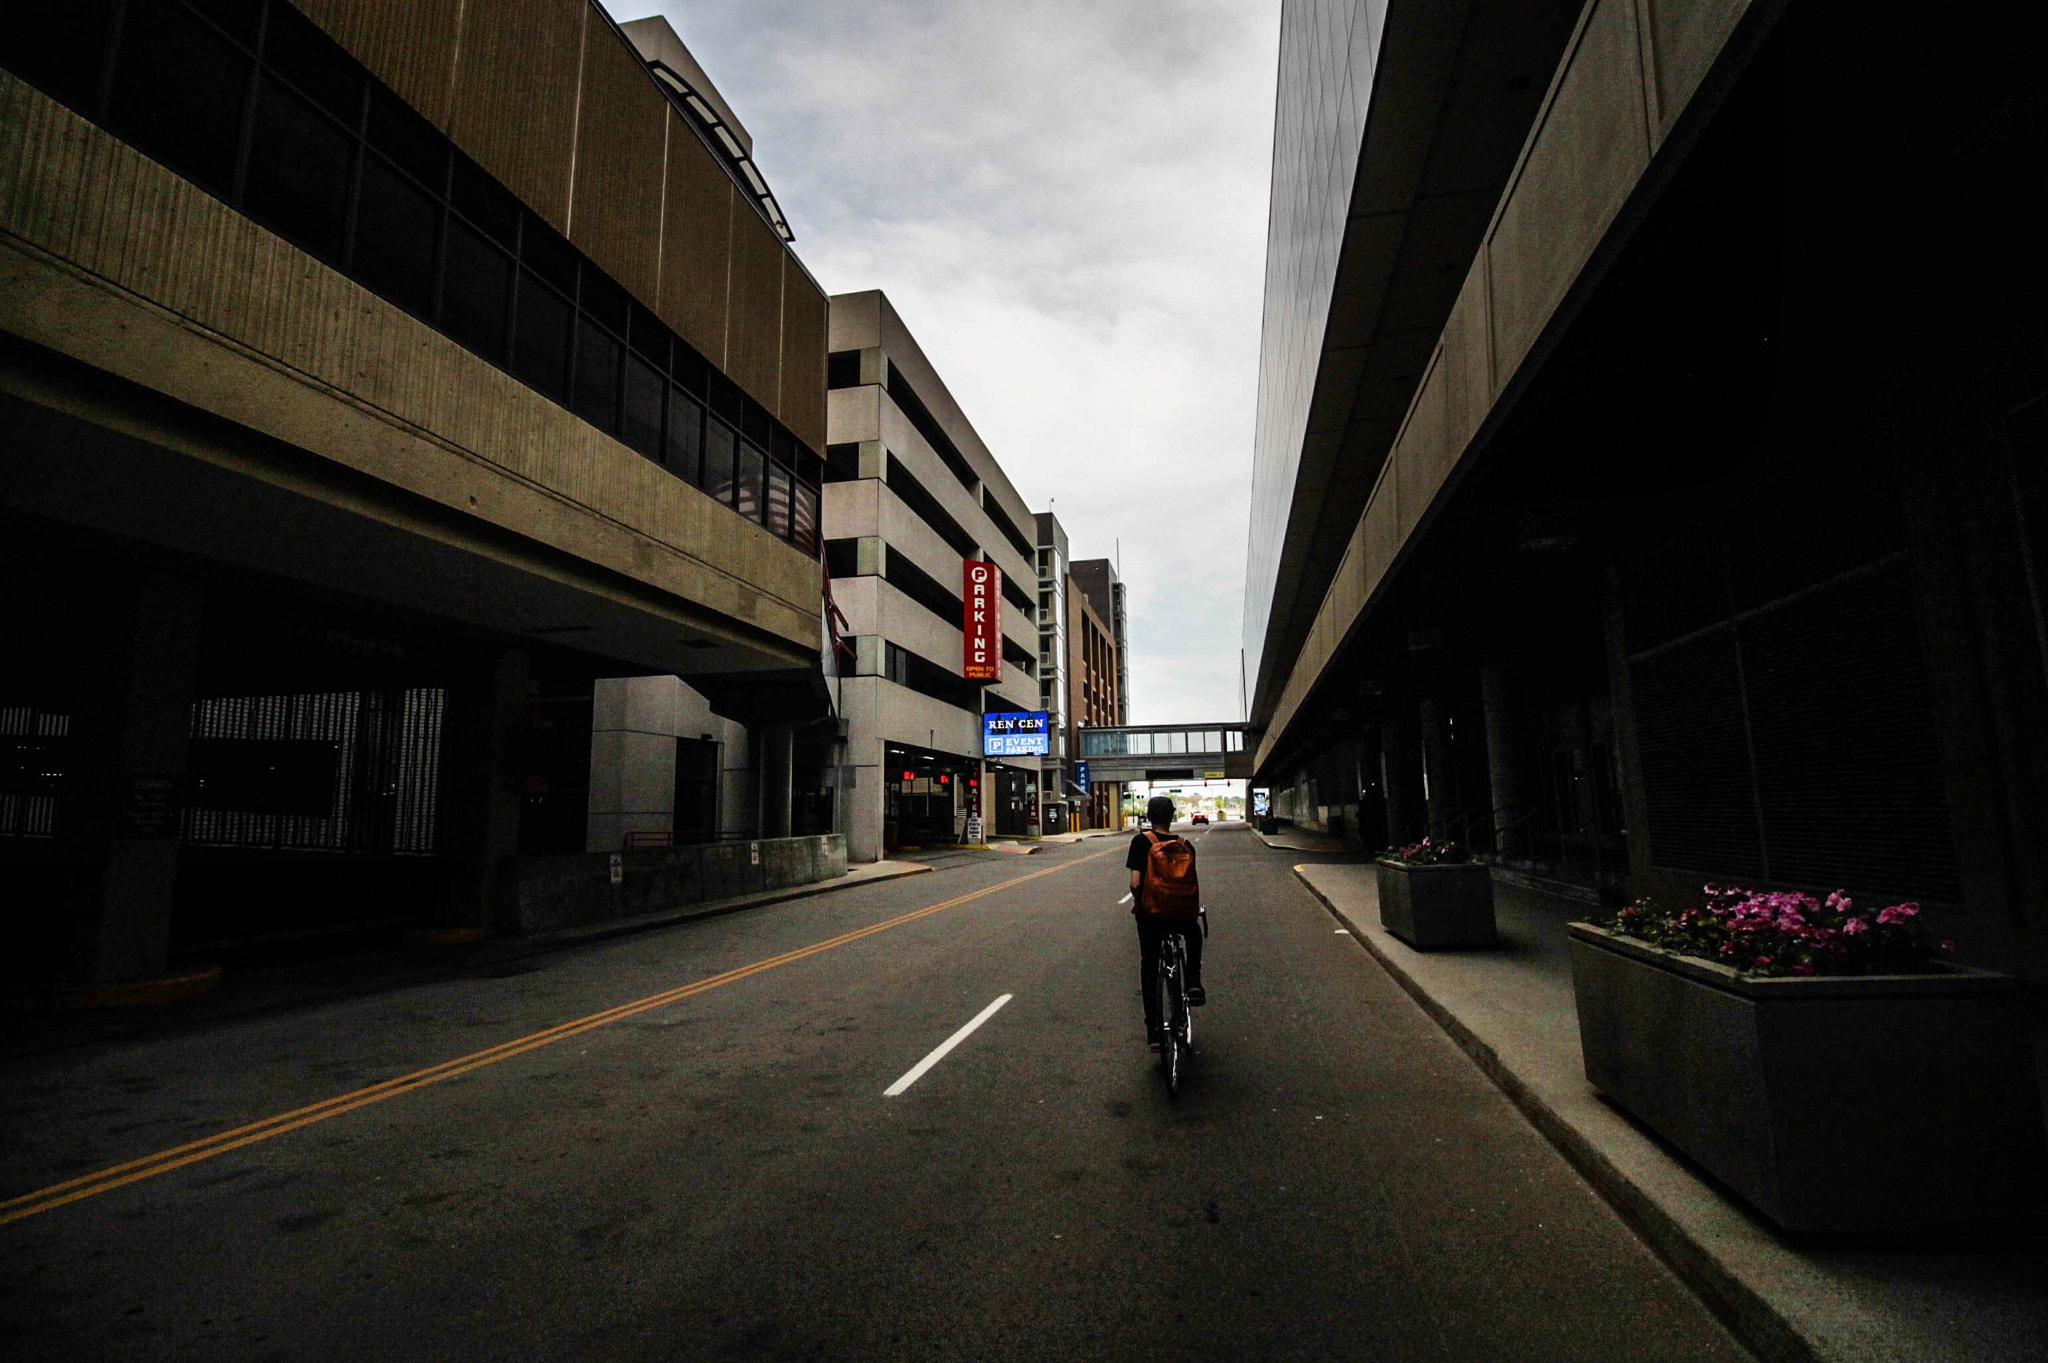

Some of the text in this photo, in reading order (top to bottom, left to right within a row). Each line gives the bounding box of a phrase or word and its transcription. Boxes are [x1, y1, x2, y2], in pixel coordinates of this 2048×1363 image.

[971, 567, 988, 663] PARKING
[988, 719, 1044, 729] REN CEN
[1005, 737, 1044, 746] EVENT
[1005, 745, 1044, 754] PARKING
